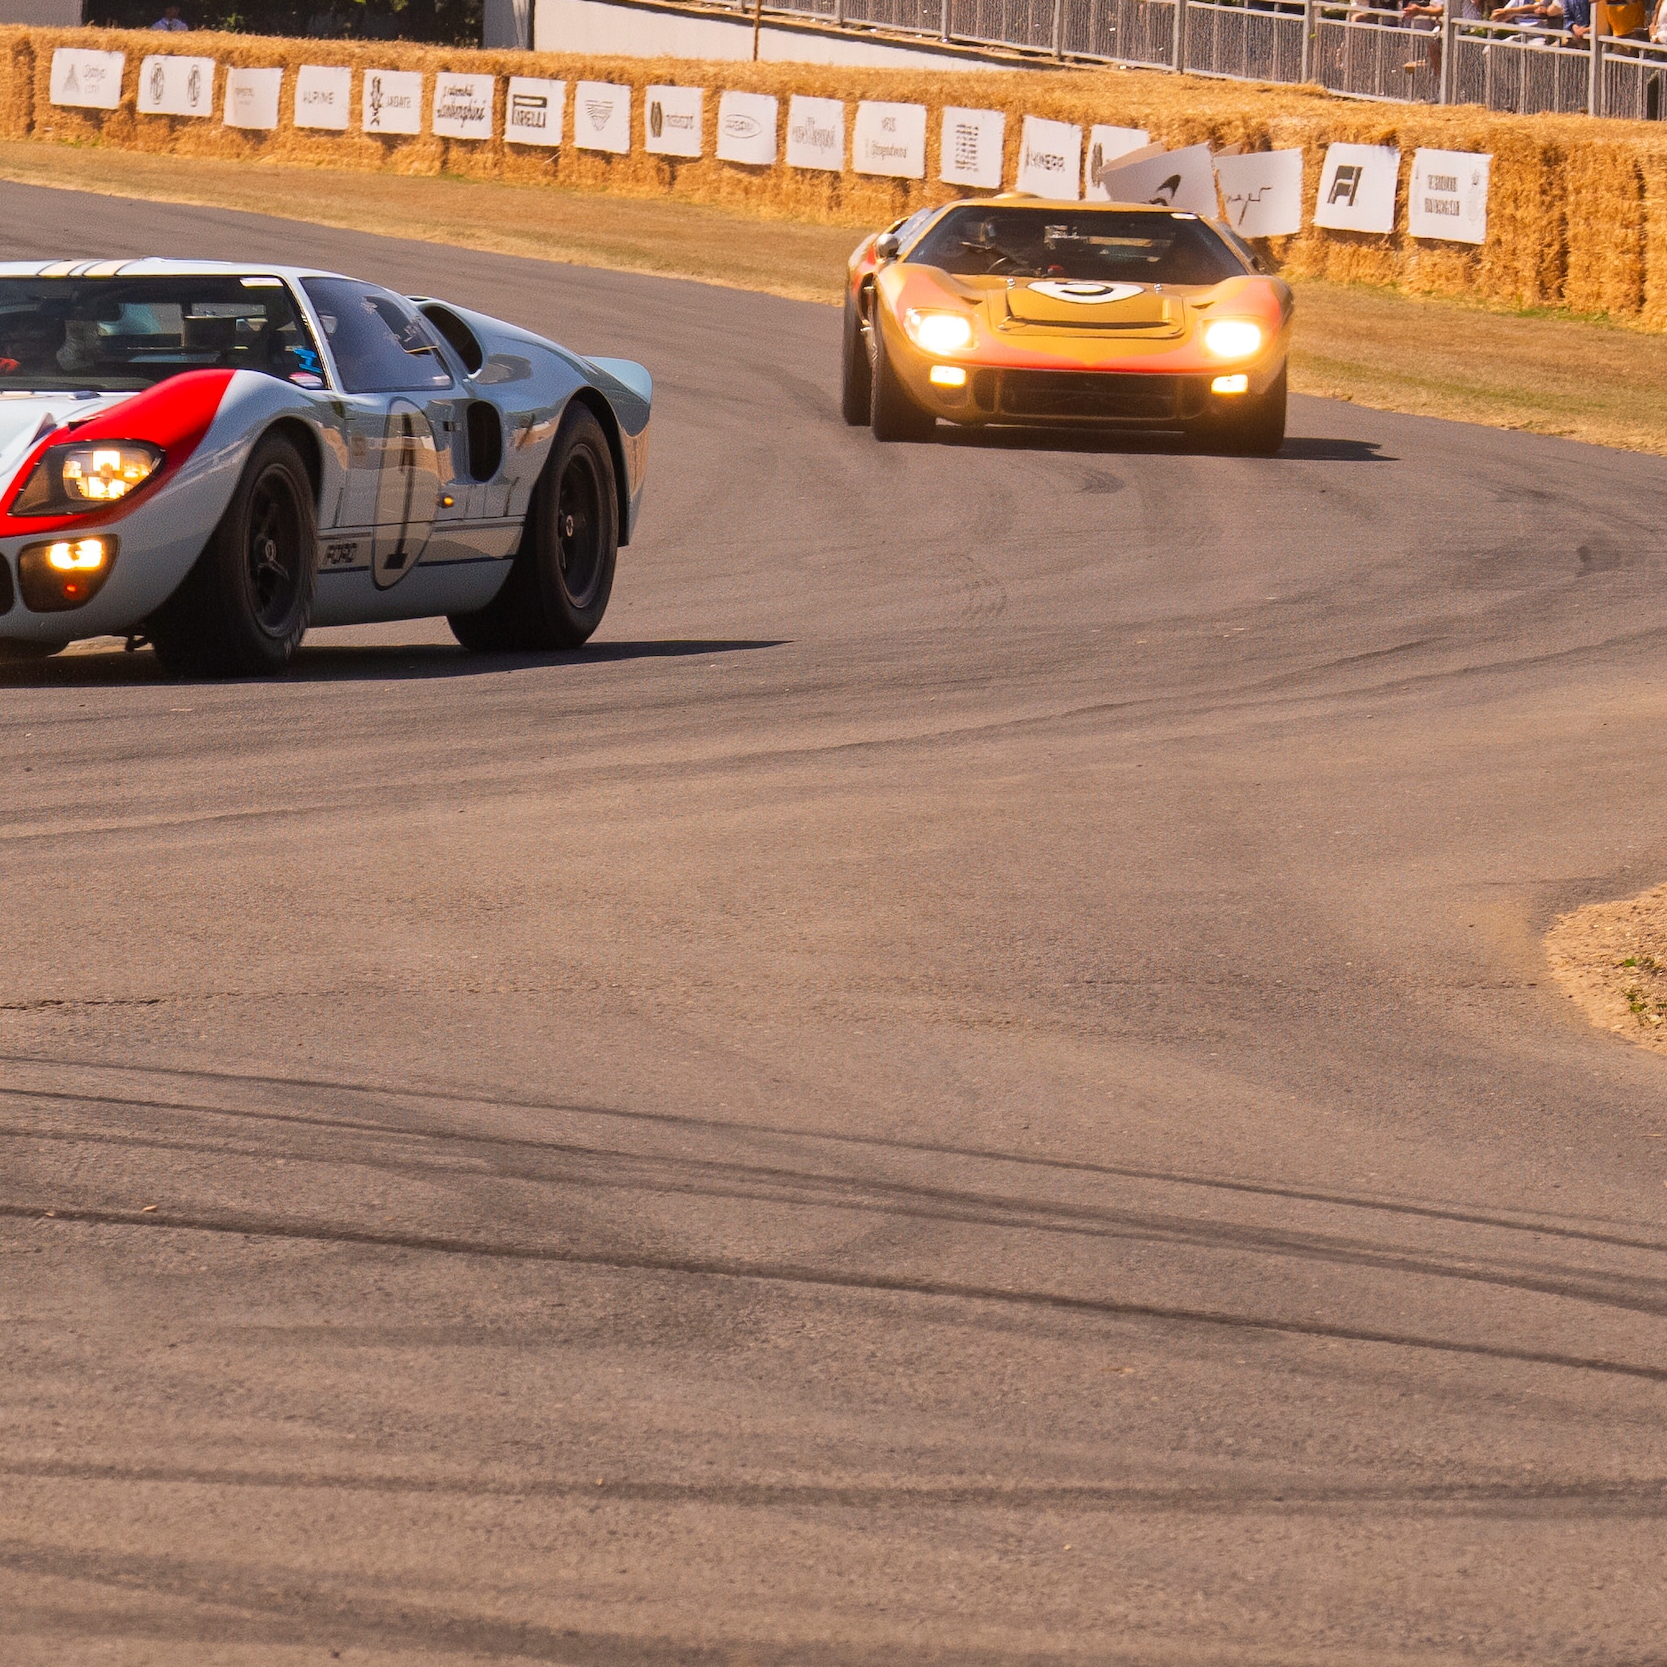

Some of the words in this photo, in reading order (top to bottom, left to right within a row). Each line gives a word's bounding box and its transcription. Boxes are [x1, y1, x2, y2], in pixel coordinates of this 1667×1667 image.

[302, 90, 335, 105] ALPINE
[382, 412, 413, 570] 1
[324, 542, 358, 565] FORD
